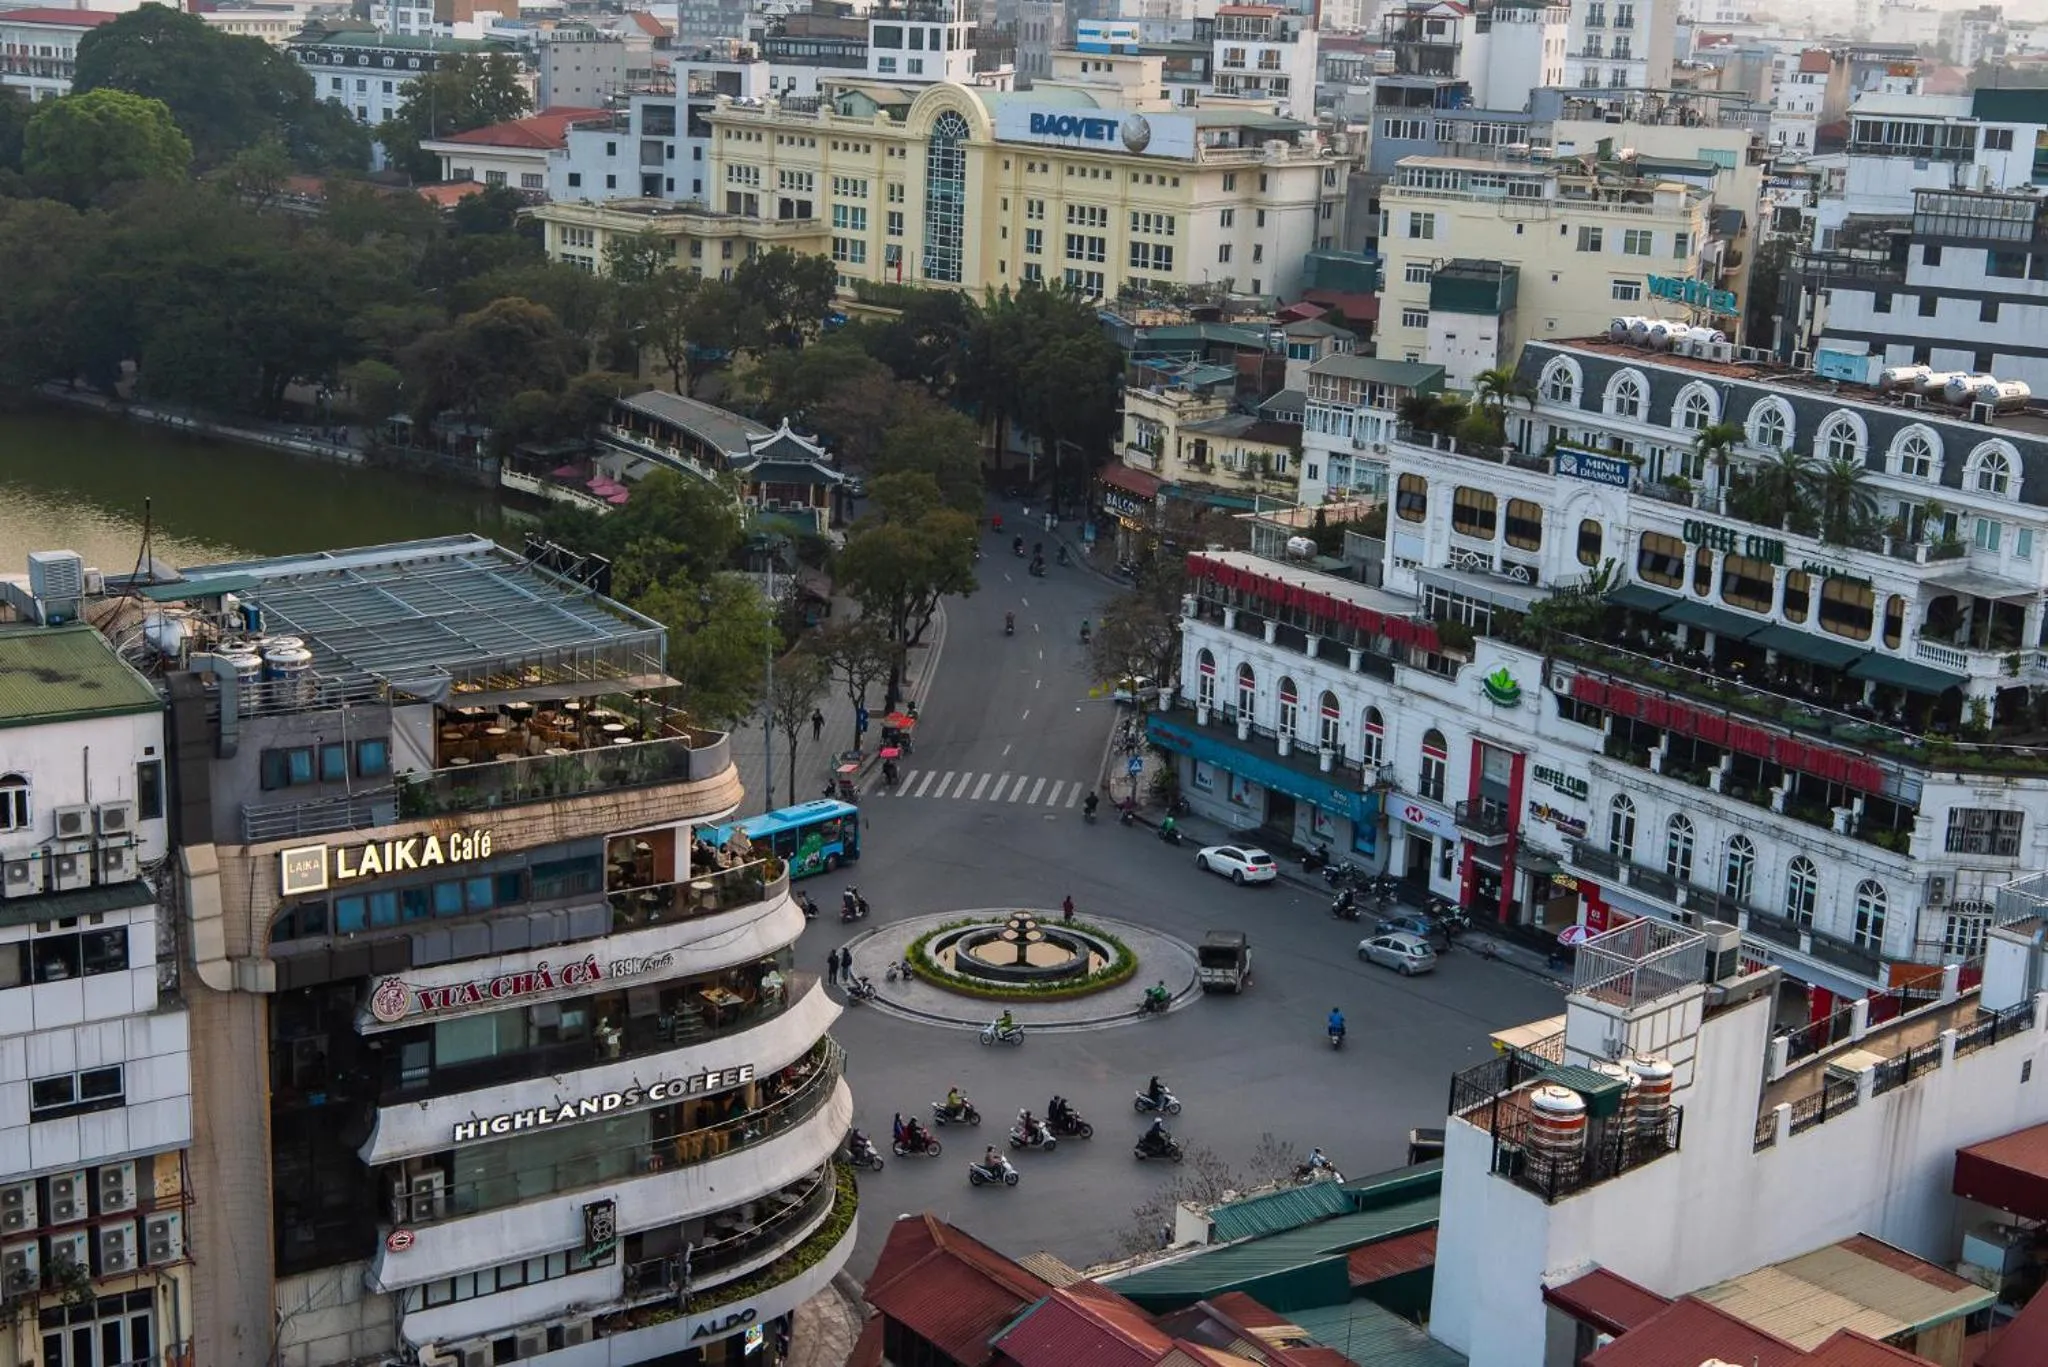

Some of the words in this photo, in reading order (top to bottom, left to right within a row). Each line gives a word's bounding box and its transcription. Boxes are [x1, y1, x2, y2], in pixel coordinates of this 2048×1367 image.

[1580, 467, 1625, 484] DIAMOND
[1585, 458, 1621, 474] MINH
[1683, 518, 1738, 555] COFFEE
[1534, 764, 1565, 787] COFFEE
[289, 859, 320, 874] LAIKA
[336, 835, 445, 879] LAIKA
[450, 830, 492, 863] Café
[416, 981, 482, 1012] VUA
[489, 961, 554, 1000] CHẢ
[561, 953, 602, 986] CÁ
[453, 1091, 642, 1142] HIGHLANDS
[648, 1064, 755, 1101] COFFEE
[691, 1308, 757, 1340] ALDO
